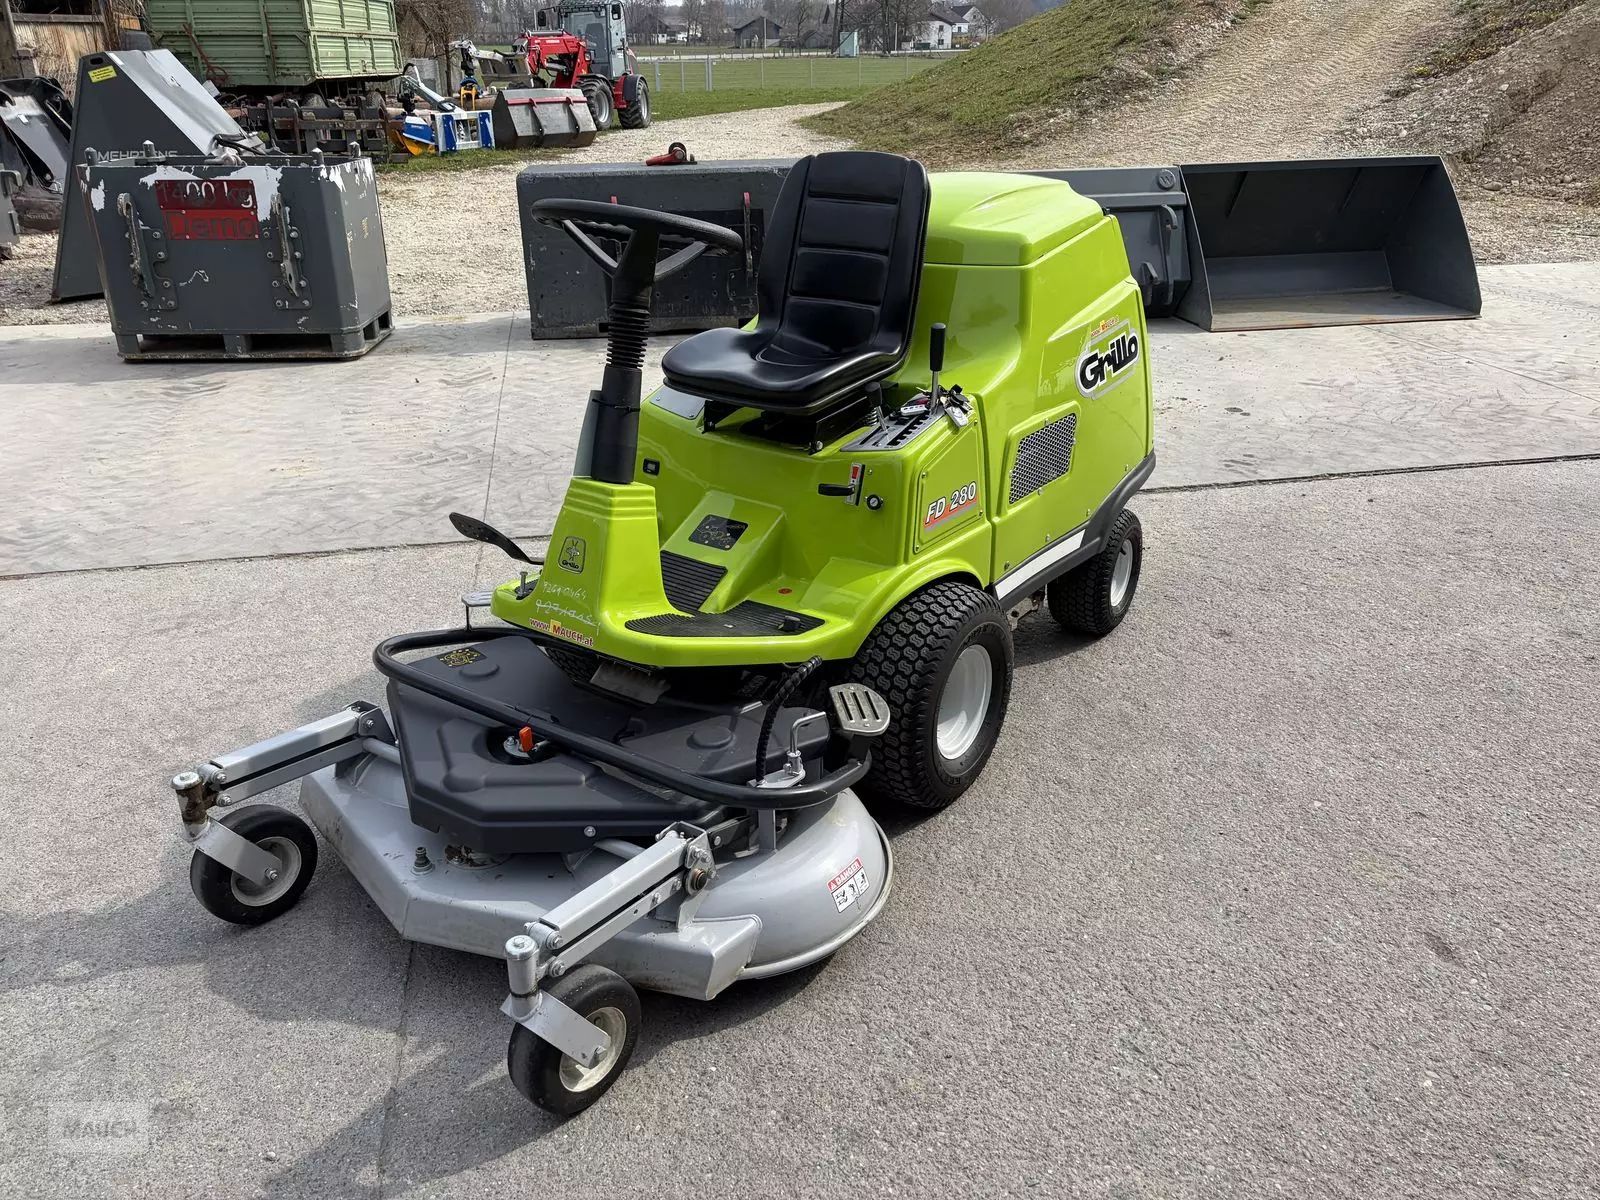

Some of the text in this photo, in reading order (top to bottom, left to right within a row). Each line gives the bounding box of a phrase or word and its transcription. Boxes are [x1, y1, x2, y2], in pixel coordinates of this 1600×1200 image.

[97, 150, 178, 161] MEHRTNS
[164, 211, 256, 239] Demo
[1079, 334, 1139, 390] Grillo
[925, 481, 977, 525] FD 280
[836, 860, 861, 886] DANGER
